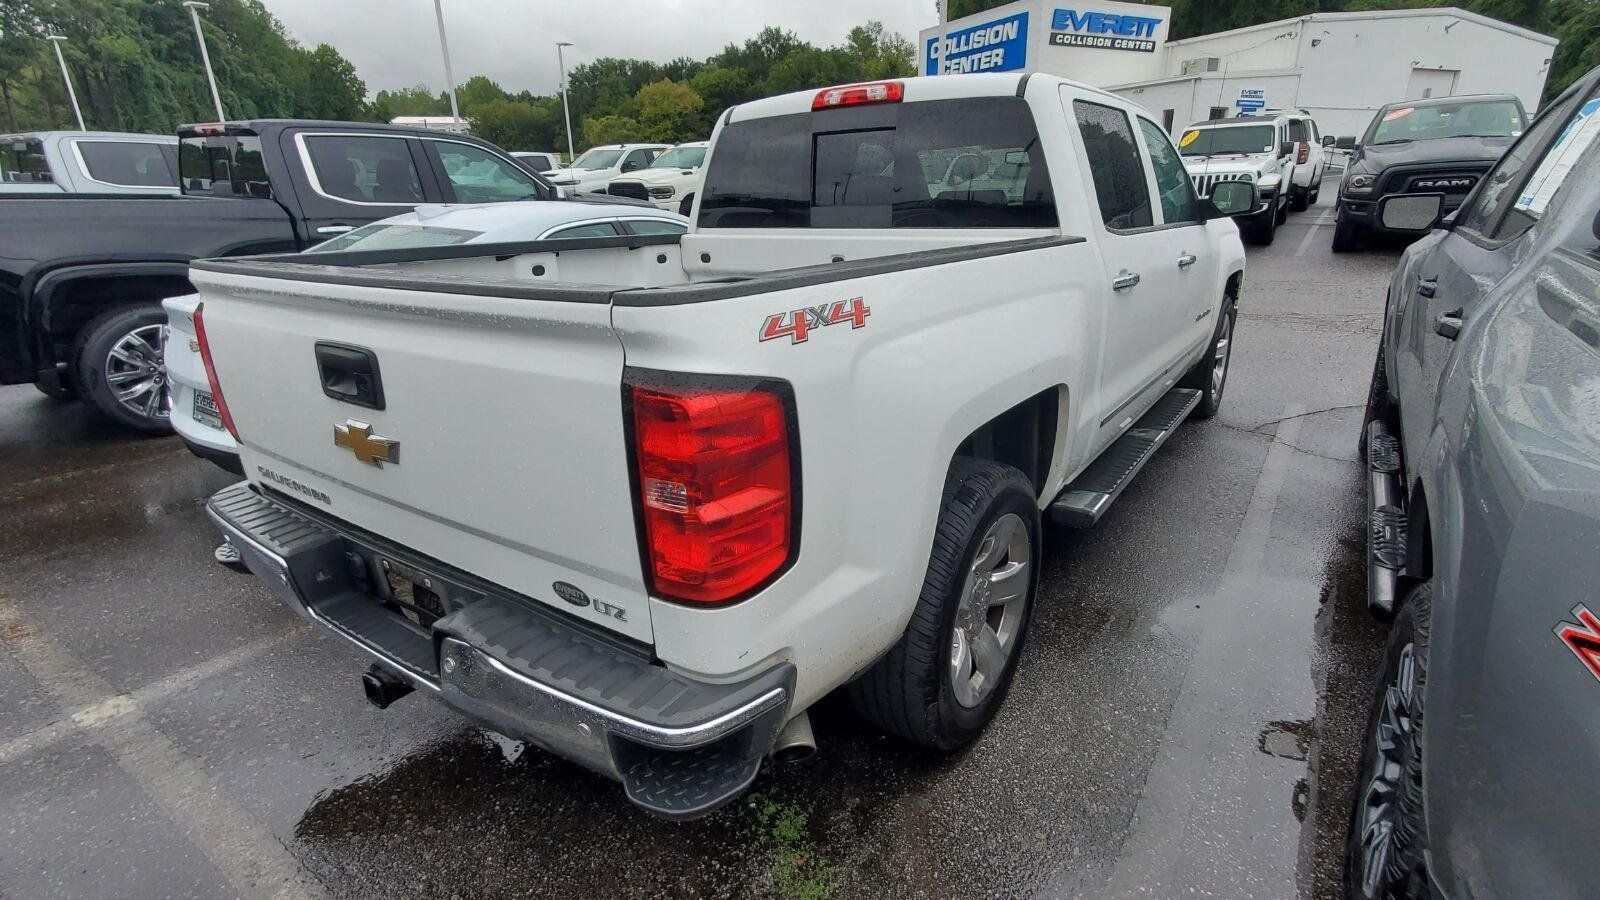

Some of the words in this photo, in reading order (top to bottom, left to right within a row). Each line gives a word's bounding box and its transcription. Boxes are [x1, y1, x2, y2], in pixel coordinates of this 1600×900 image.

[1051, 8, 1163, 38] EVERETT
[930, 20, 1019, 59] COLLISION
[1055, 34, 1111, 47] COLLISION
[1114, 40, 1154, 50] CENTER
[944, 48, 1004, 75] CENTER
[593, 598, 628, 622] LTZ
